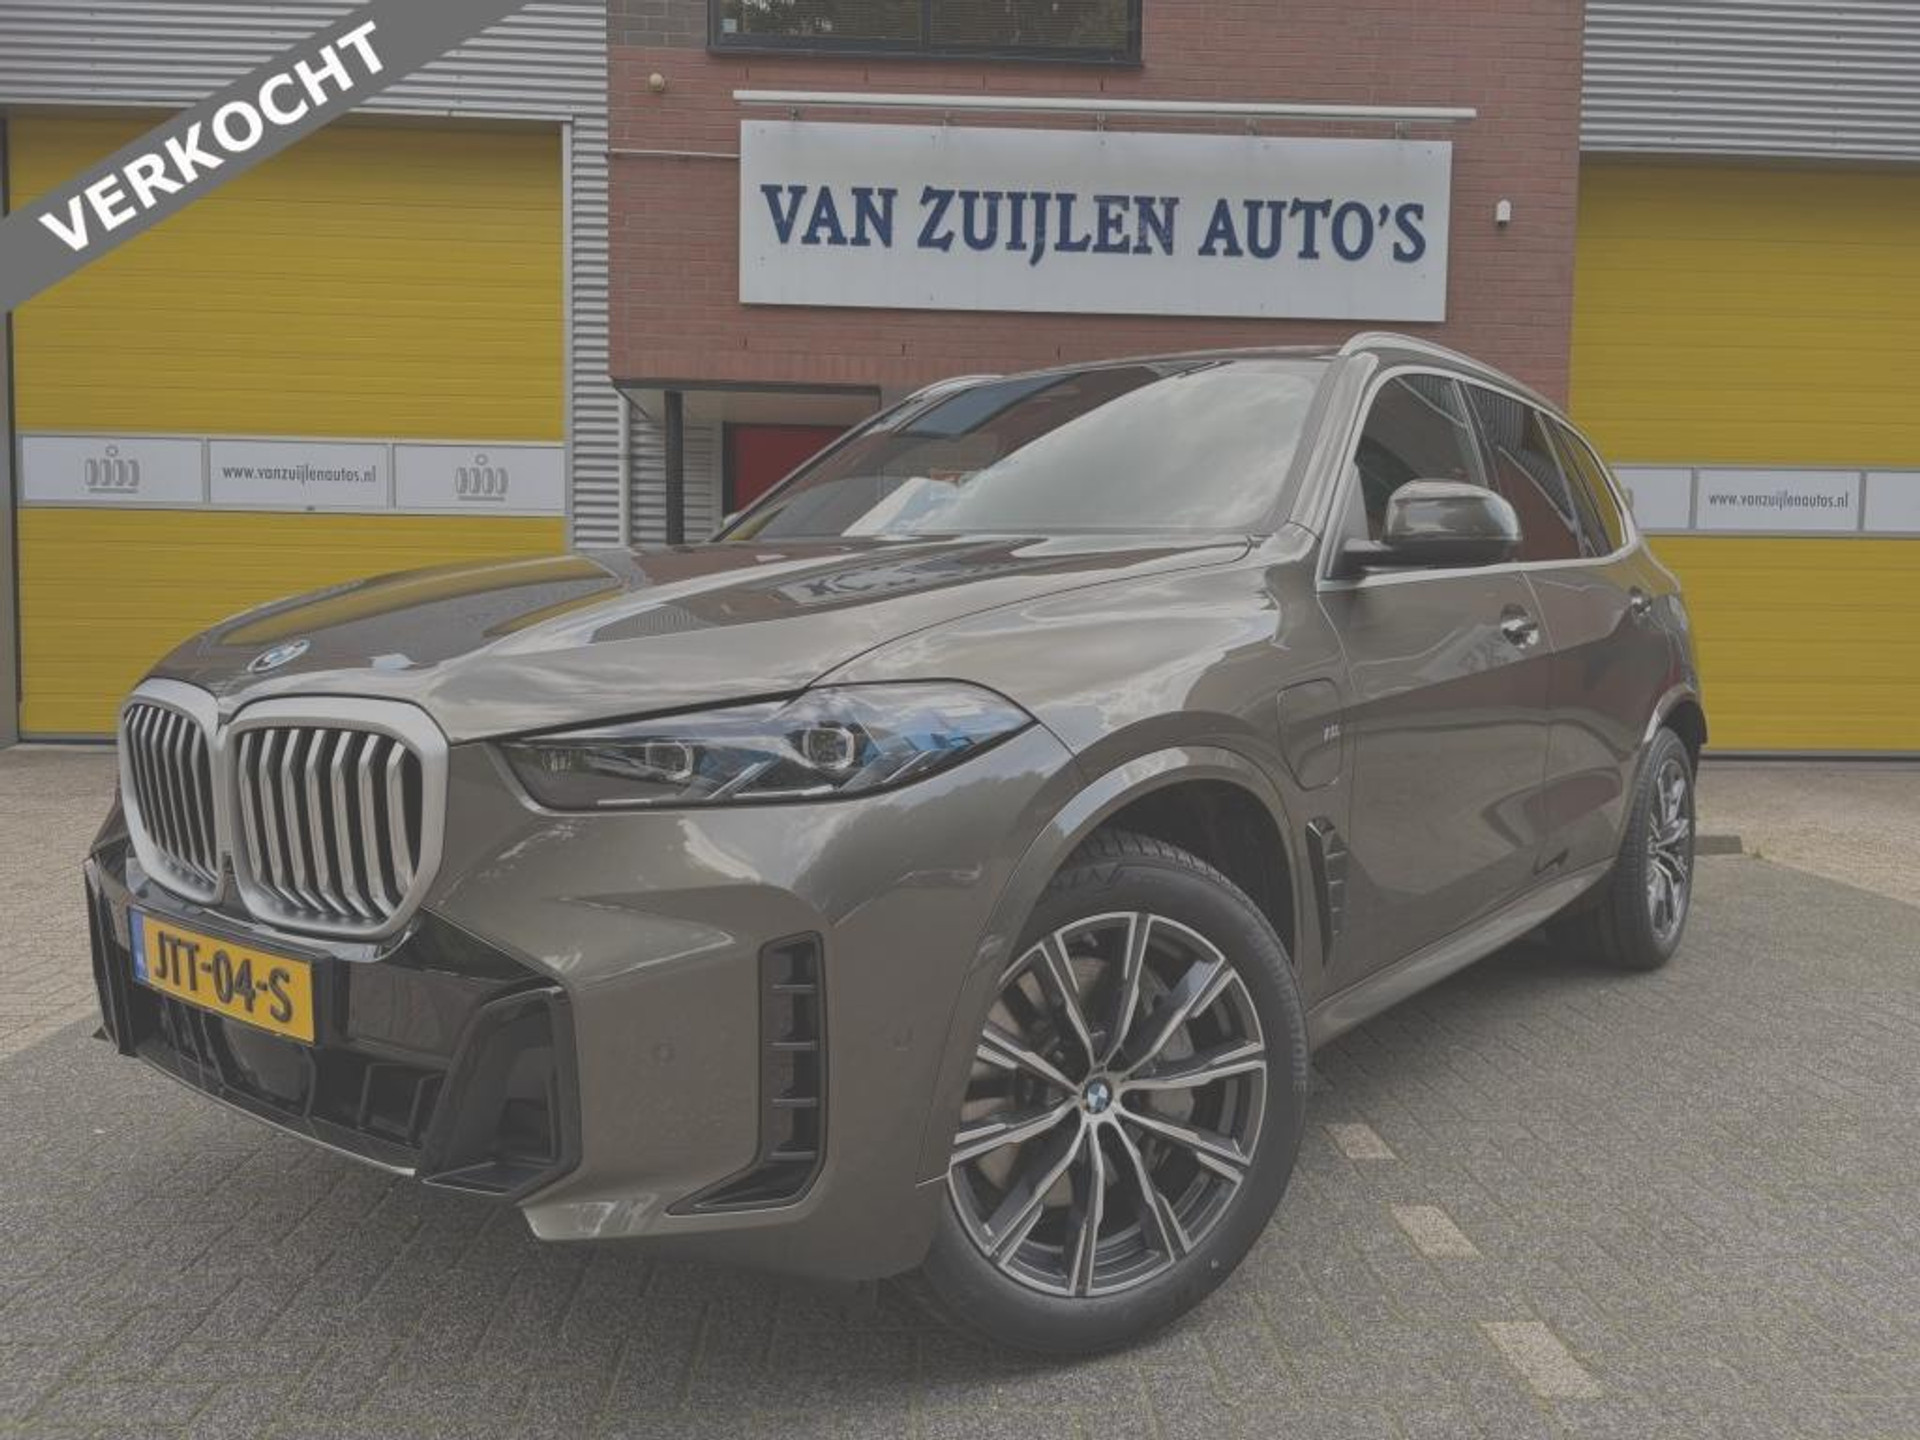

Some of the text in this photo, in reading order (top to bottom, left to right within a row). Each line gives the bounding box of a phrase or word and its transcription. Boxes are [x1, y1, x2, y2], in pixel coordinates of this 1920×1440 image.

[760, 184, 1426, 266] VAN ZUIJLEN AUTO'S
[222, 463, 377, 487] www.vanzuijlenautos.nl
[1709, 489, 1849, 511] www.vanzuijlenautos.nl
[153, 930, 293, 1023] JTT-04-S
